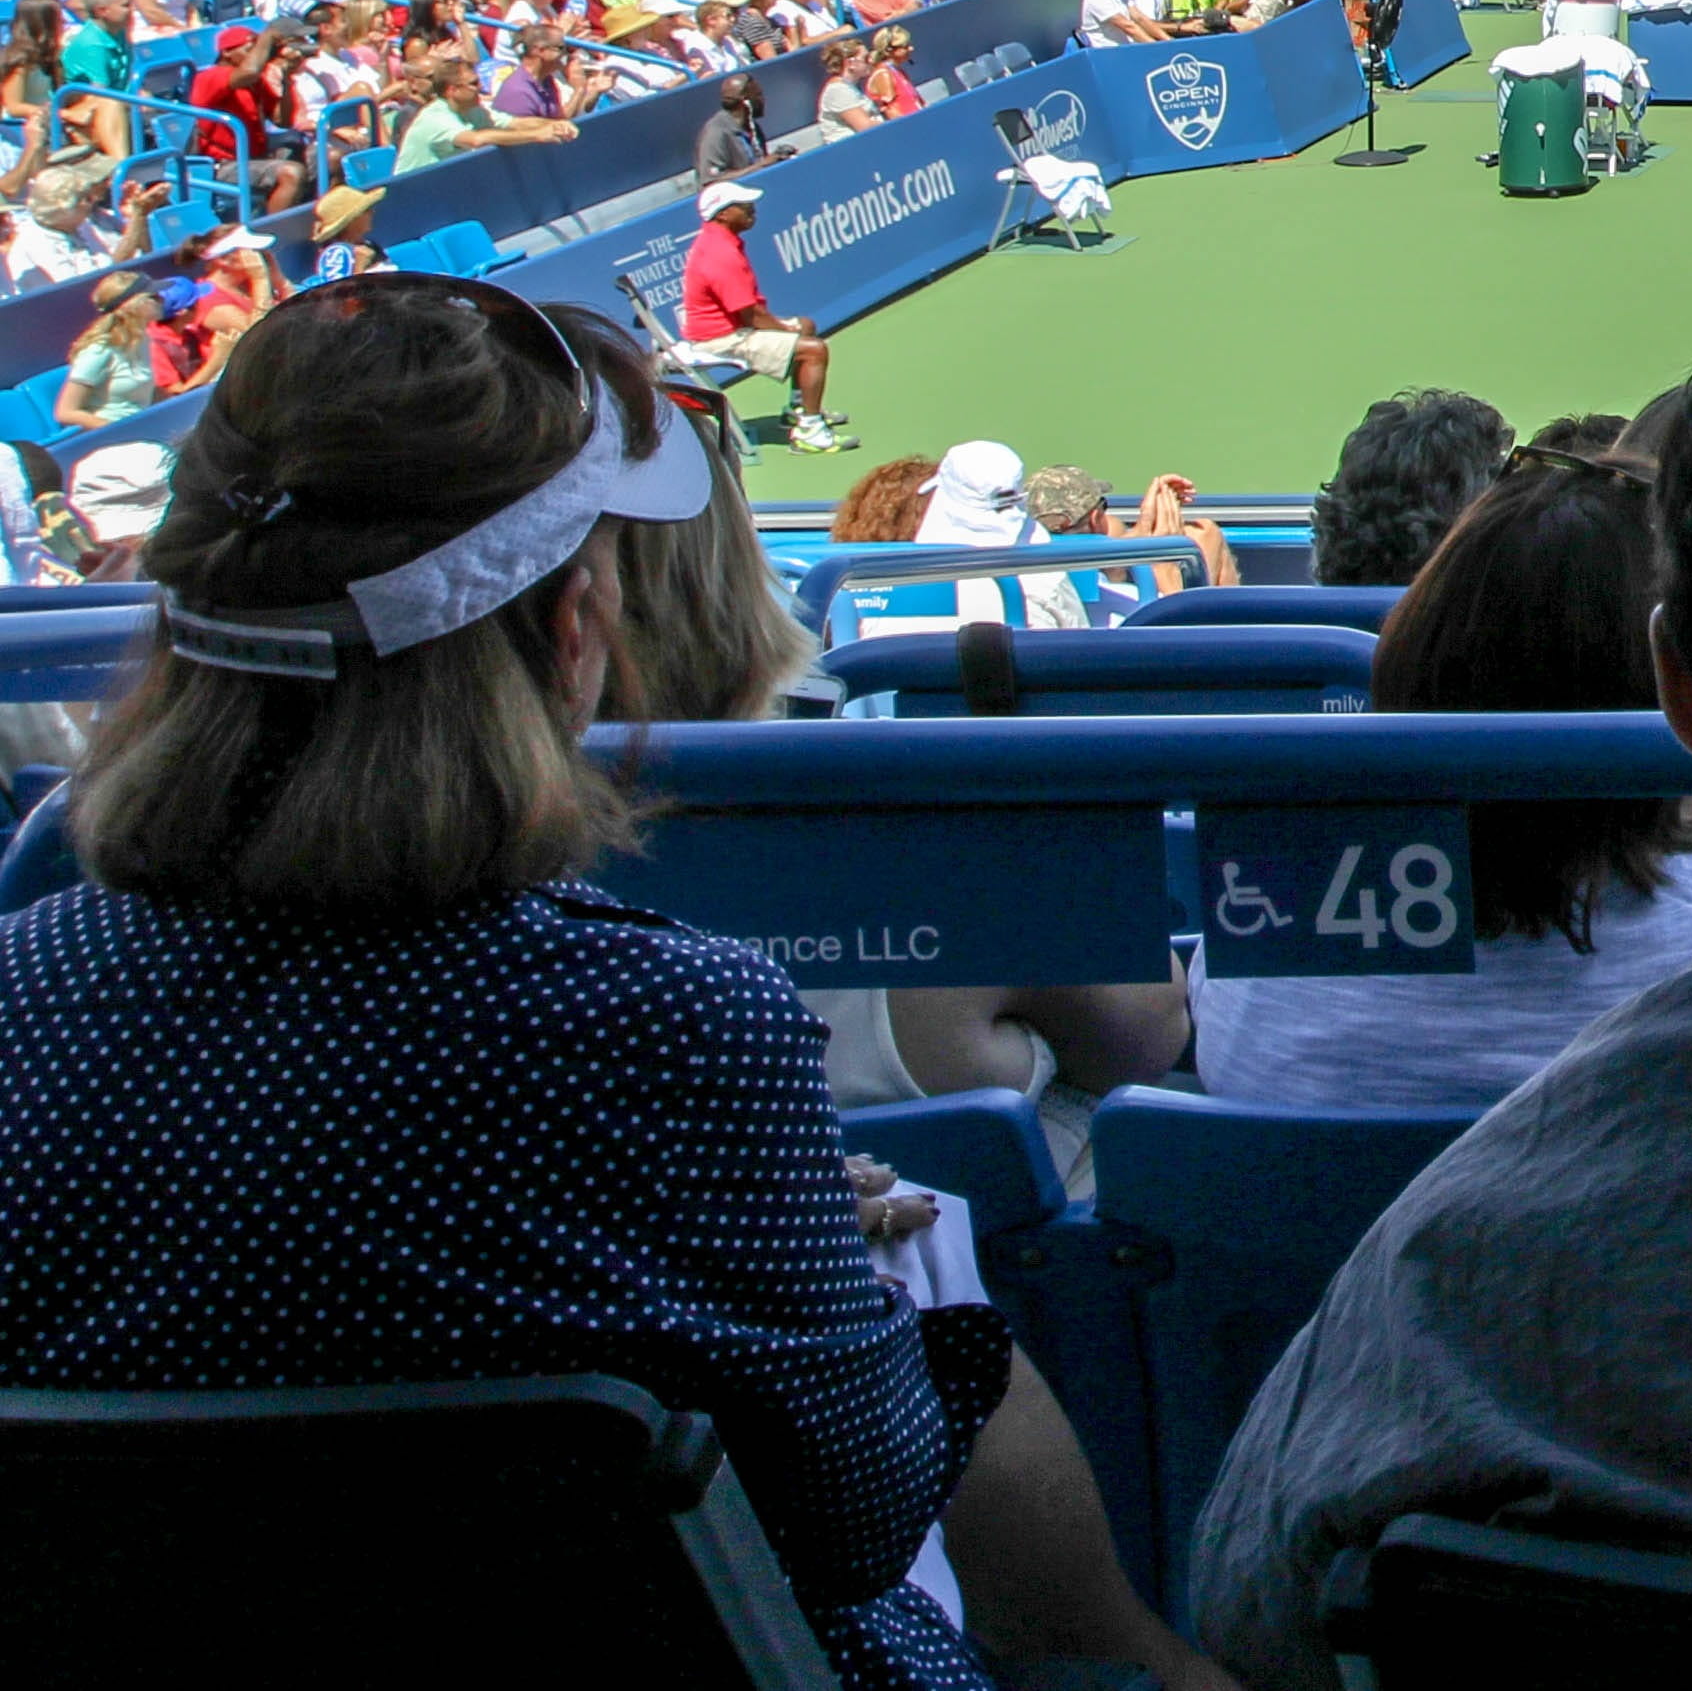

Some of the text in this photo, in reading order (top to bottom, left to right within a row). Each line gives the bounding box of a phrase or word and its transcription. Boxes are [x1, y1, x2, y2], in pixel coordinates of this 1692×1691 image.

[1158, 85, 1220, 104] OPEN
[1162, 98, 1220, 111] CINCINNATI
[772, 158, 956, 274] wtatennis.com
[645, 233, 676, 258] THE
[626, 259, 673, 289] RIVATE
[643, 277, 684, 309] RESE
[1314, 843, 1459, 950] 48
[857, 925, 941, 961] LLC
